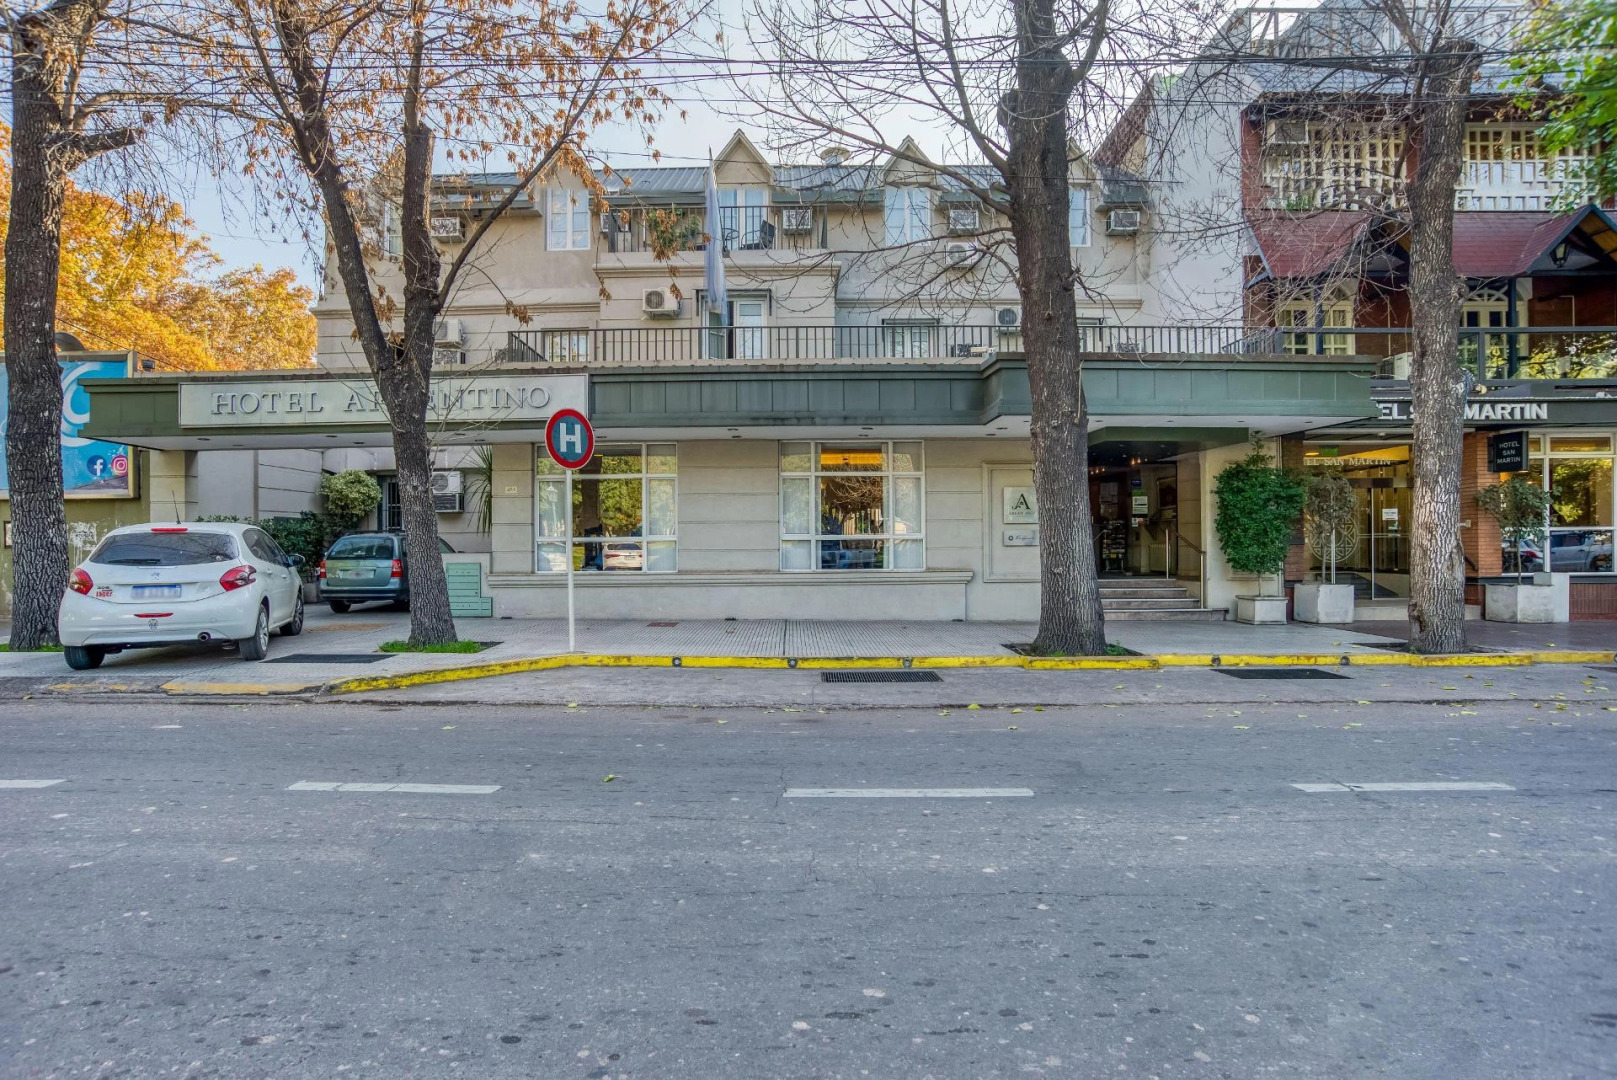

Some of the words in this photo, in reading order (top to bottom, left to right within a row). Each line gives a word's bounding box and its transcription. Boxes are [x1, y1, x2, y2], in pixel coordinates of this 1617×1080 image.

[211, 392, 324, 414] HOTEL
[343, 384, 552, 412] ANTINO
[1376, 403, 1407, 421] EL
[1463, 403, 1548, 421] MARTIN
[559, 422, 582, 454] H
[1499, 441, 1520, 449] HOTEL
[1324, 458, 1344, 466] SAN
[1349, 457, 1391, 466] MARTIN
[1496, 456, 1521, 464] MARTIN
